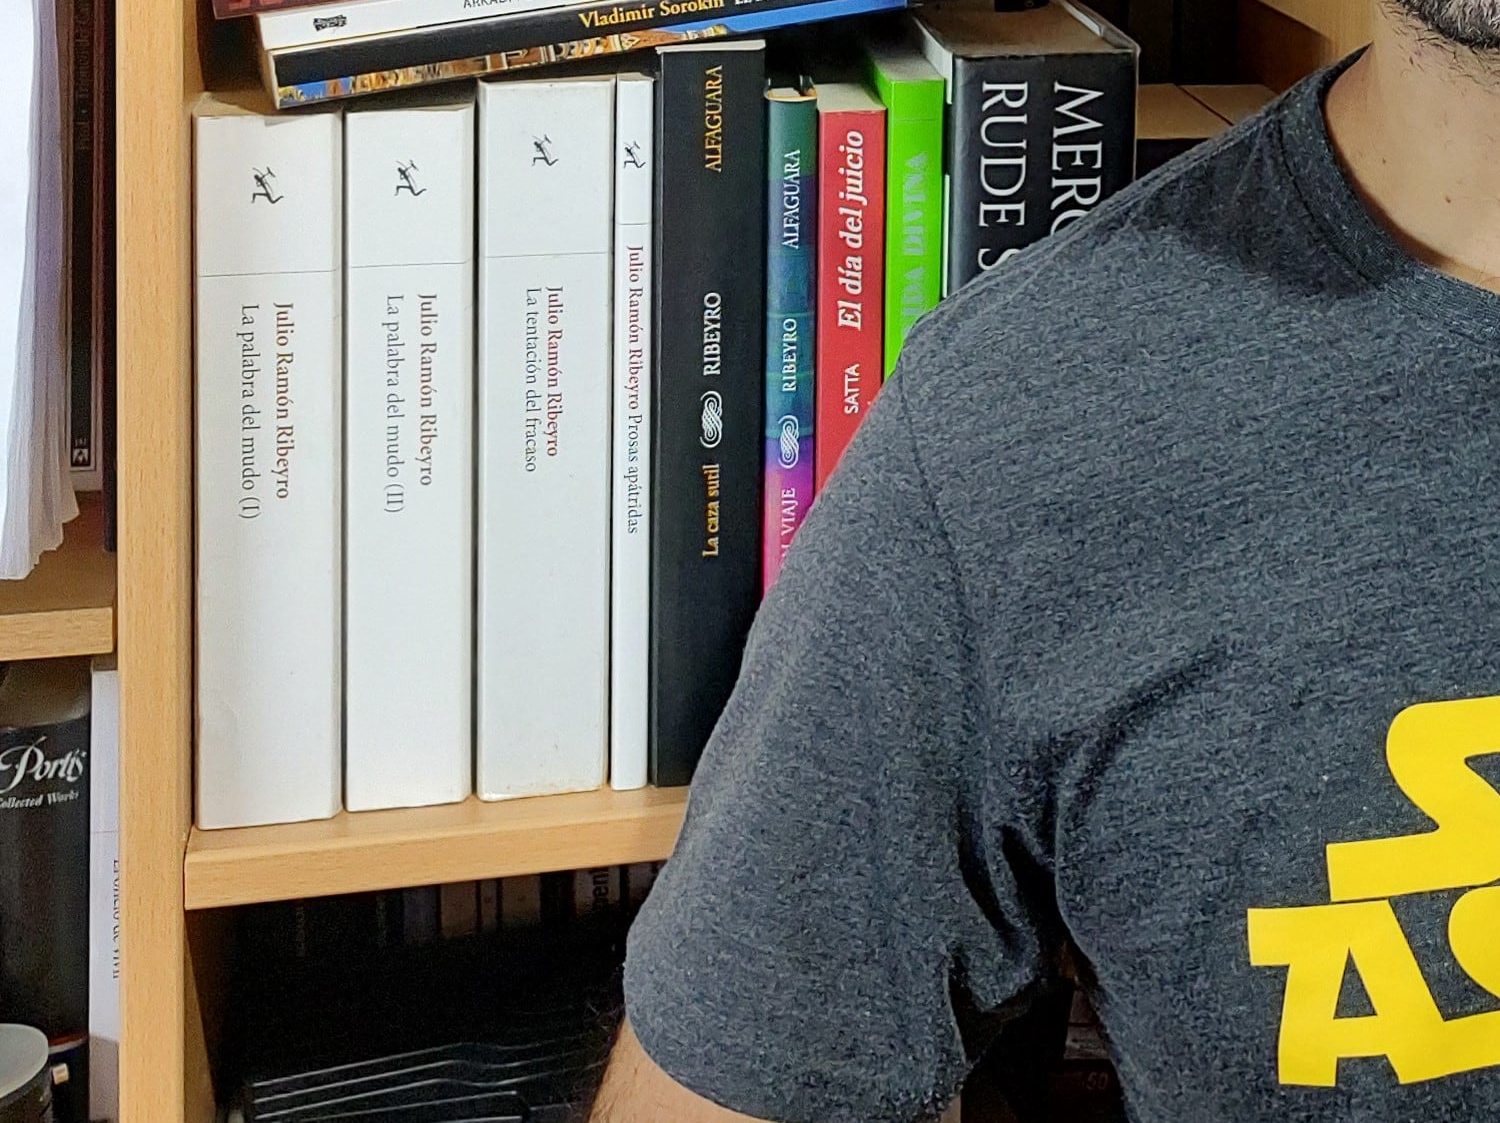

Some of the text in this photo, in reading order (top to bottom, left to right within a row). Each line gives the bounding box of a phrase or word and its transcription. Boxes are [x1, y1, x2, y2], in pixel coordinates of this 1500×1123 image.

[579, 4, 655, 28] Vladimir
[704, 64, 723, 173] ALFAGUARA
[979, 81, 1029, 228] RUDE
[781, 148, 801, 250] ALFAGUARA
[837, 129, 868, 332] El día del juicio
[271, 302, 295, 499] Julio Ramón Ribeyro
[381, 295, 406, 513] La palabra del mudo (II)
[414, 294, 439, 486] Julio Ramón Ribeyro
[525, 287, 543, 473] La tentación del fracaso
[543, 286, 564, 457] Julio Ramón Ribeyro
[623, 245, 646, 536] Julio Ramón Ribeyro Prosas apátridas
[703, 291, 722, 377] RIBEYRO
[781, 317, 798, 393] RIBEYRO
[844, 363, 860, 415] SATTA
[235, 304, 262, 519] La palabra del mudo (I)
[701, 463, 720, 557] La caza sutil
[780, 487, 796, 538] VIAJE
